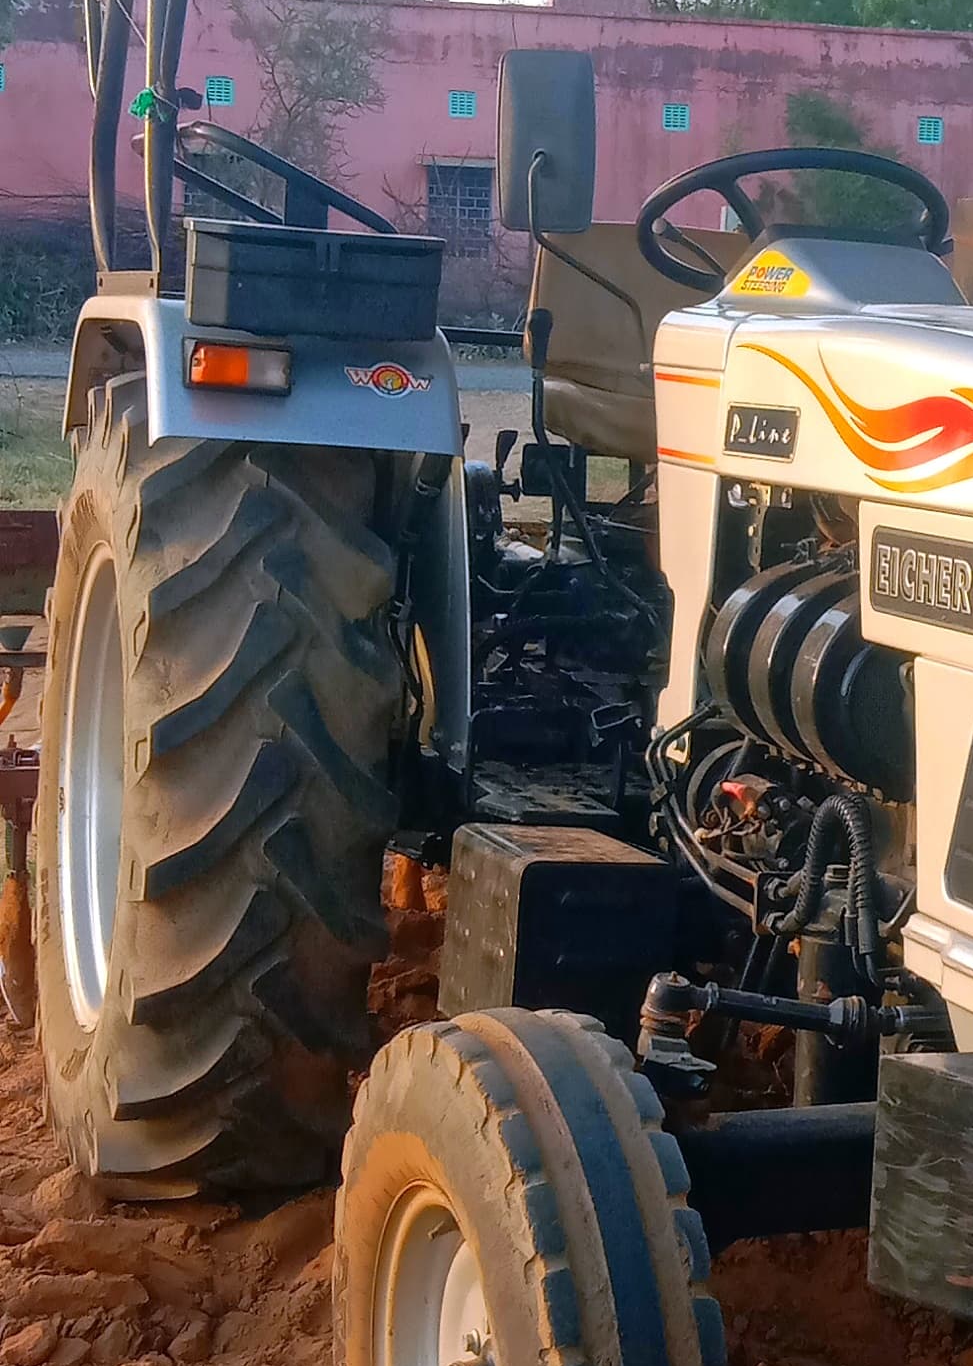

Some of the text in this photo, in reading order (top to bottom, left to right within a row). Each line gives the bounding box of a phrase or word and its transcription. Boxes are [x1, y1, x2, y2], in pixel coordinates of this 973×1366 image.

[747, 266, 794, 281] POWER
[741, 280, 786, 292] STEERING
[344, 363, 431, 396] WOW
[875, 543, 973, 615] EICHER
